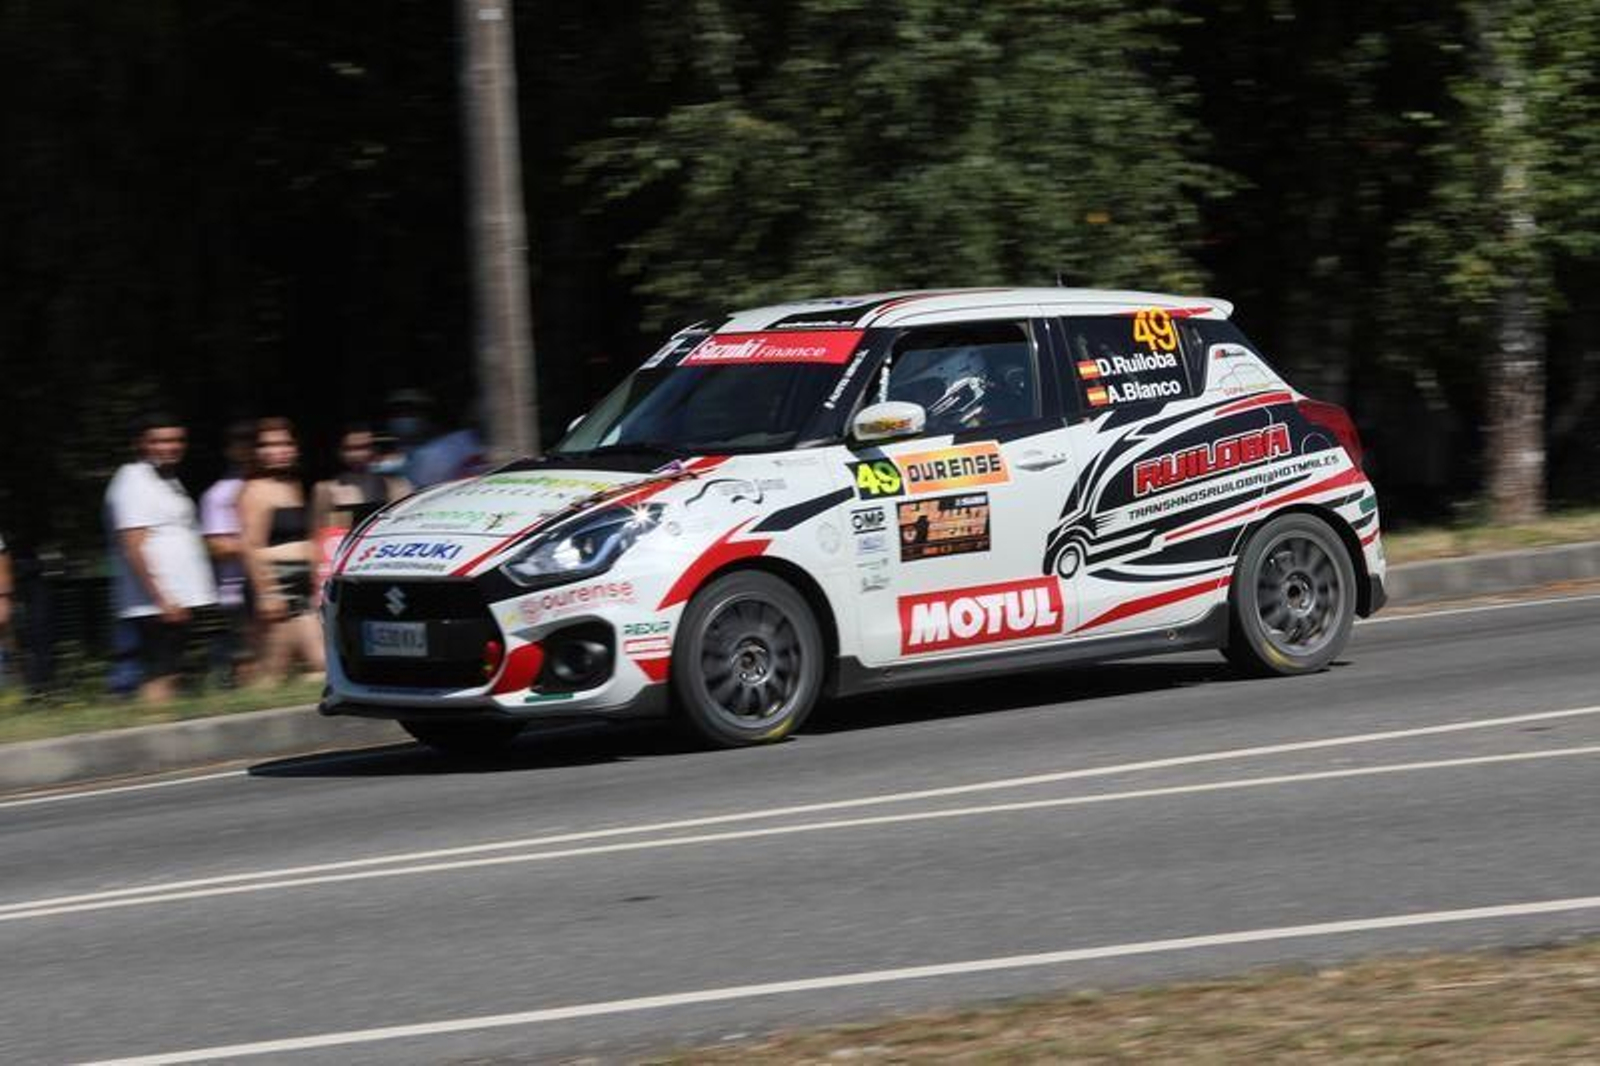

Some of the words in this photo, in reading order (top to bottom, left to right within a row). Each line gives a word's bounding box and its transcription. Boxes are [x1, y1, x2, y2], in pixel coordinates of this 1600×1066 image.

[1132, 308, 1178, 351] 49
[756, 345, 826, 359] Finance
[1097, 352, 1178, 377] D.Ruiloba
[1107, 379, 1182, 404] A.Blanco
[907, 453, 1002, 483] OURENSE
[1133, 423, 1293, 497] RUILOBA
[857, 461, 901, 495] 49
[851, 510, 886, 530] OMP
[374, 543, 463, 560] SUZUKI
[543, 582, 634, 610] ourense
[908, 587, 1059, 646] MOTUL
